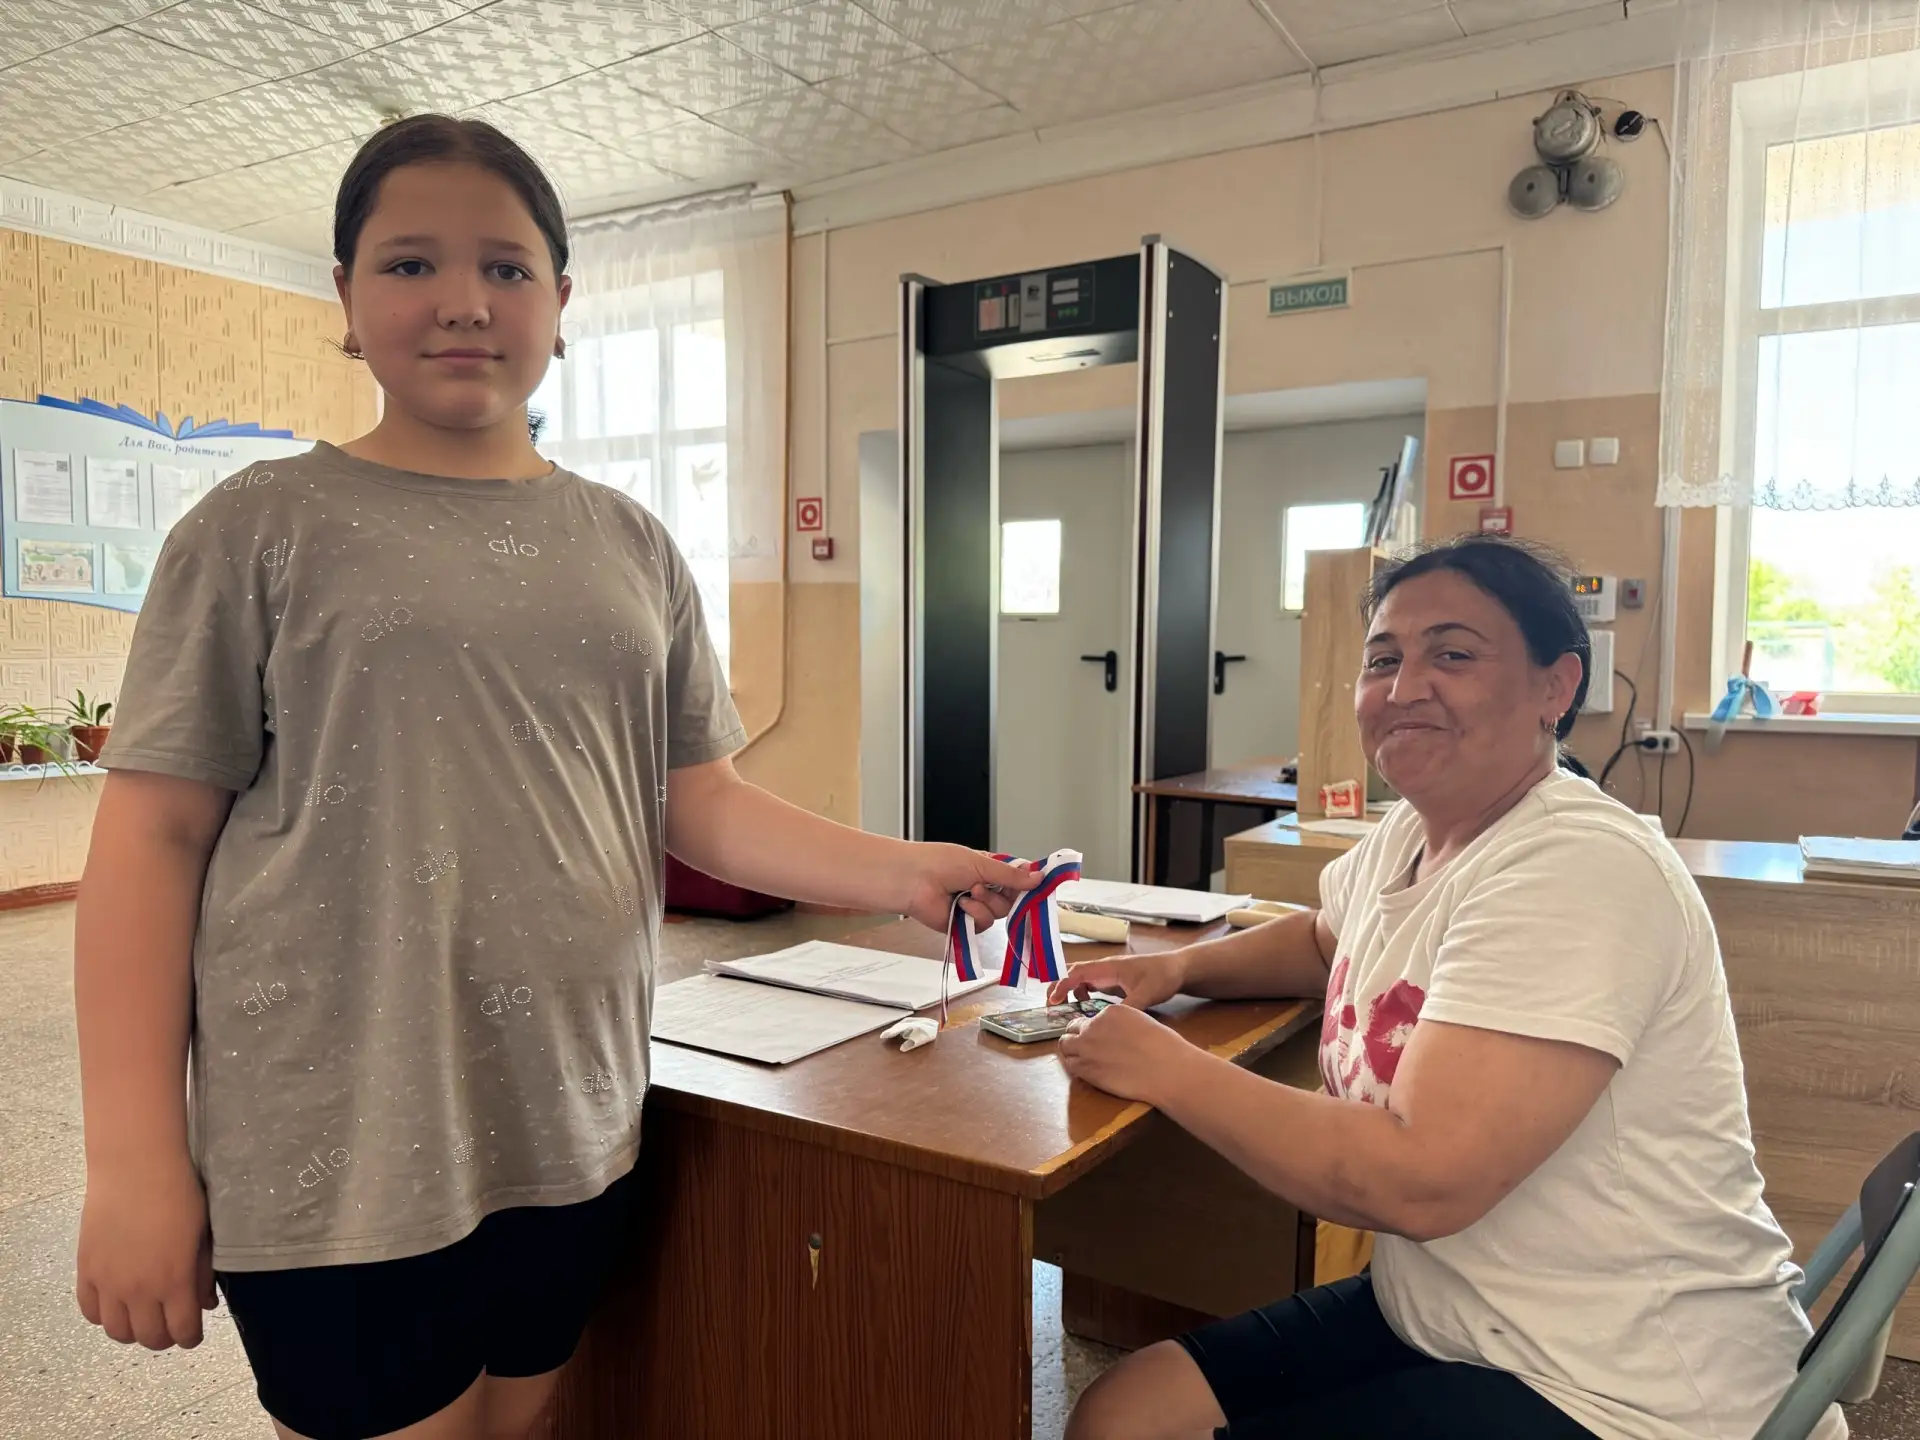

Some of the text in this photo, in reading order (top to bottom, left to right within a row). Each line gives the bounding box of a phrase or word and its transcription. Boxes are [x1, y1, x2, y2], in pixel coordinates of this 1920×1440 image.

[1273, 283, 1344, 308] ВЫХОД
[119, 435, 234, 459] Для Вас, родители!
[223, 468, 275, 491] alo
[487, 534, 540, 557] alo
[361, 607, 413, 642] alo
[414, 849, 459, 884] alo
[243, 981, 288, 1016] alo
[480, 983, 533, 1016] alo
[298, 1148, 350, 1188] alo
